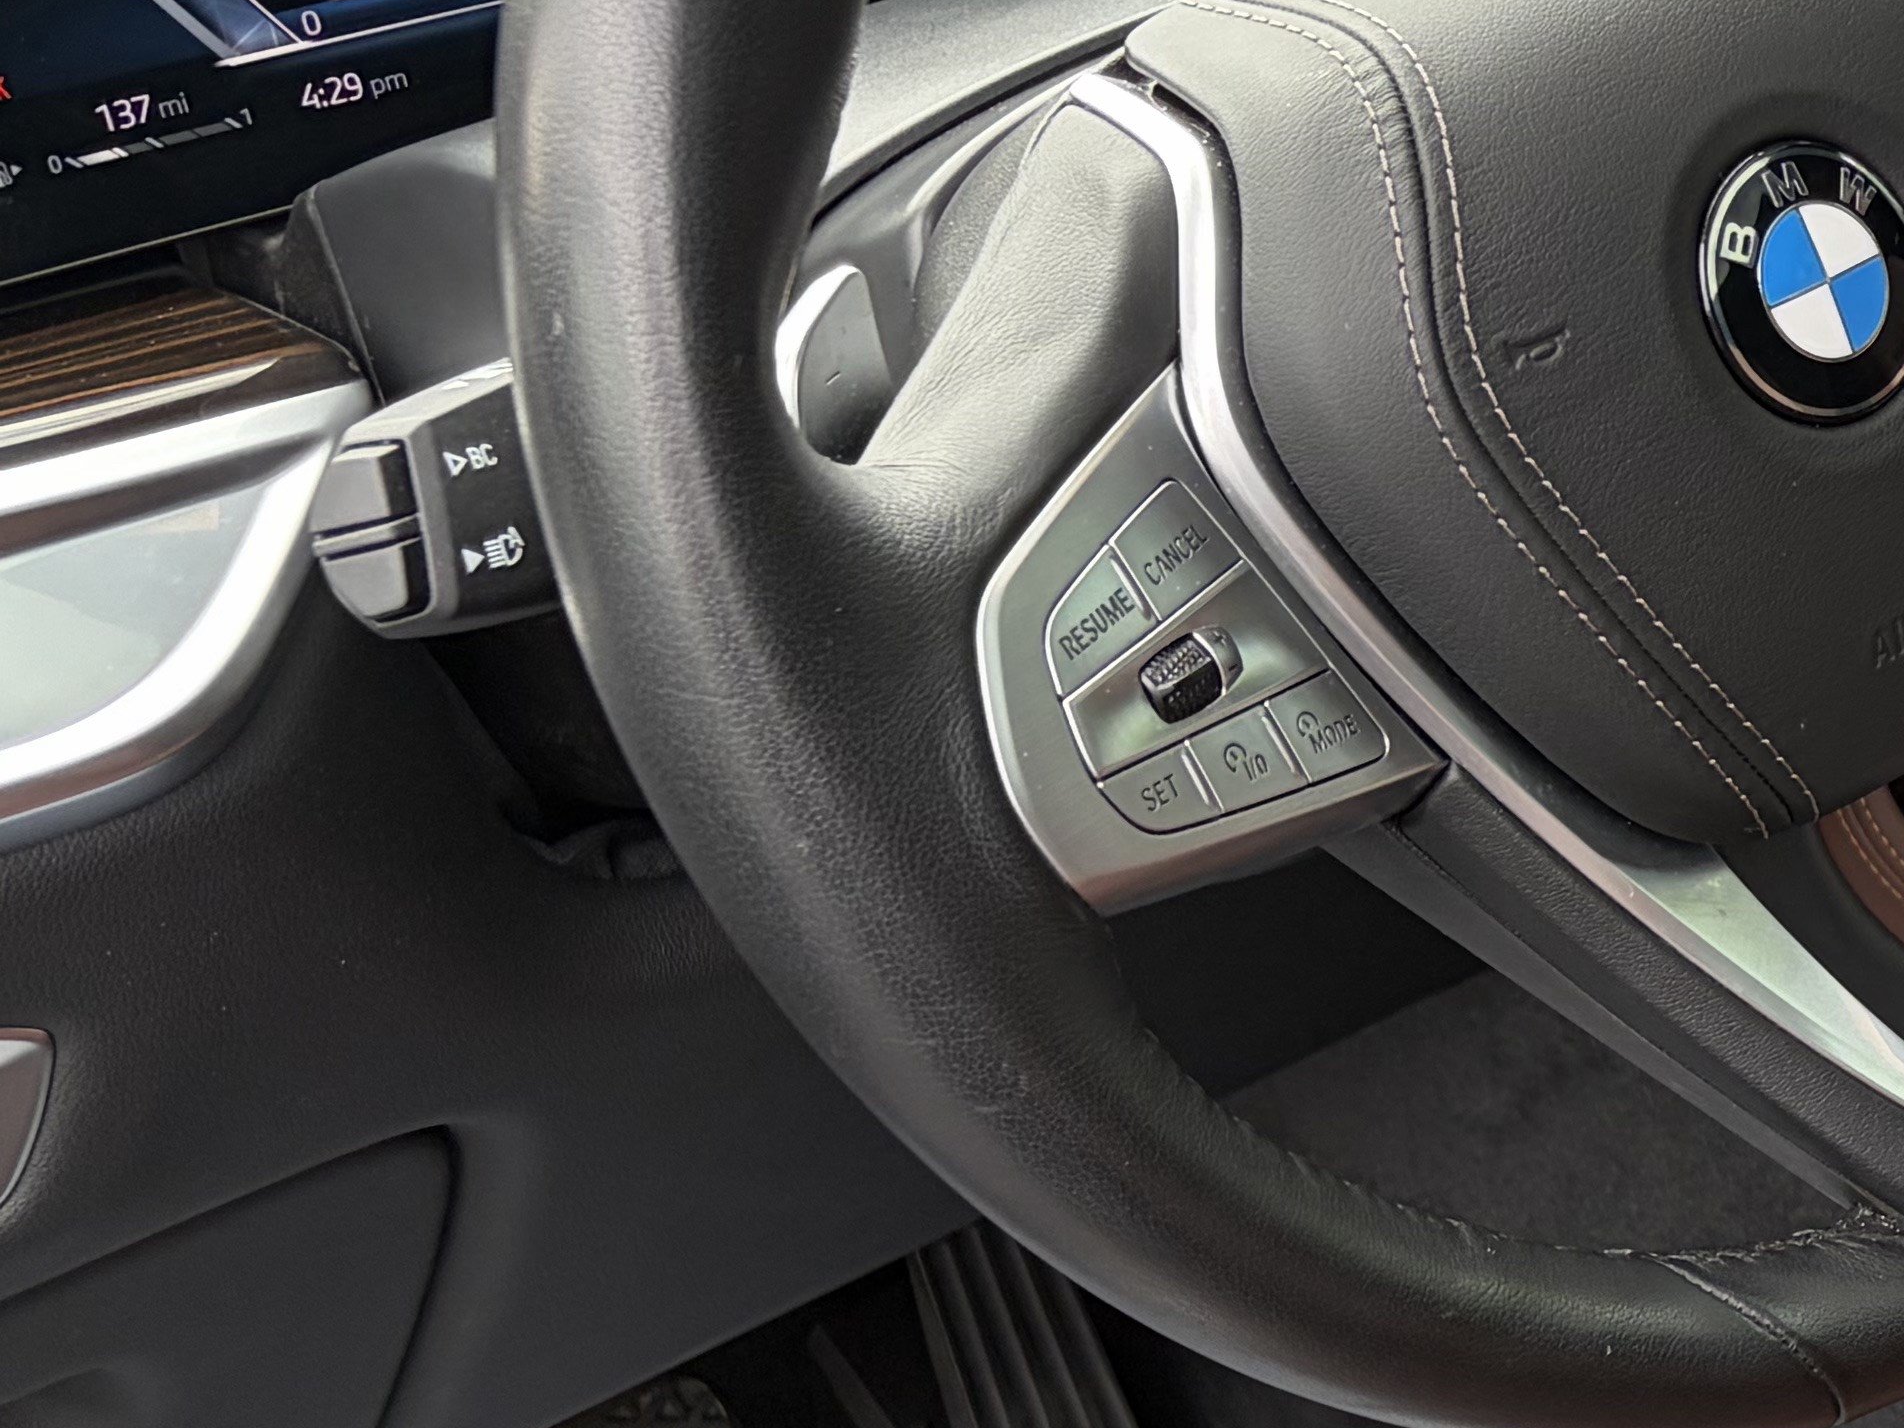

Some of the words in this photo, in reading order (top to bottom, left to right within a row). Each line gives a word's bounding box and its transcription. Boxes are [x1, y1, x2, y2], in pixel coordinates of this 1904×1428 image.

[300, 9, 323, 37] 0
[301, 72, 364, 110] 4:29
[369, 71, 409, 101] pm
[94, 93, 151, 133] 137
[158, 91, 191, 120] mi
[47, 154, 63, 176] 0
[1719, 160, 1878, 270] BMW
[1143, 522, 1209, 587] CANCEL
[1057, 586, 1136, 661] RESUME
[1309, 710, 1359, 755] MODE
[1139, 772, 1181, 814] SET
